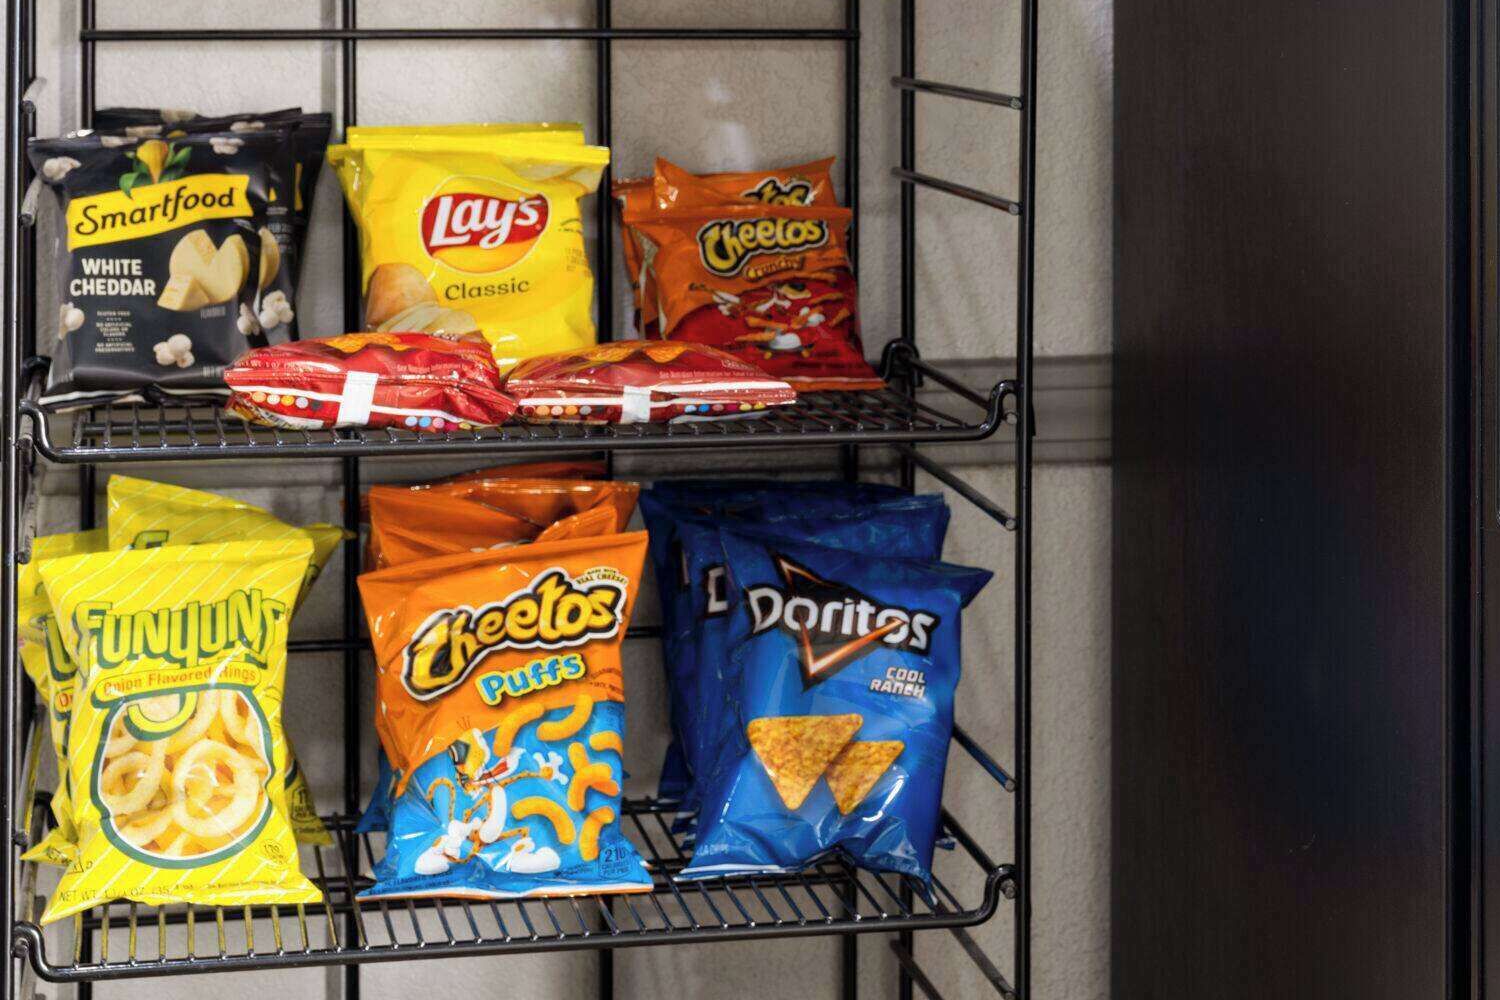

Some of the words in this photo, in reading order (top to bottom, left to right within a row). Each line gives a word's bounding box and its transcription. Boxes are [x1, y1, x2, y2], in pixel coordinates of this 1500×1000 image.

[75, 186, 235, 236] Smartfood
[430, 195, 543, 249] Lay's
[81, 257, 143, 276] WHITE
[702, 218, 824, 271] Cheetos
[69, 279, 156, 296] CHEDDAR
[445, 278, 531, 301] Classic
[73, 589, 287, 674] FUNYUNS
[410, 570, 623, 691] Cheetos
[748, 586, 938, 651] Doritos
[148, 667, 212, 687] Flavored
[482, 655, 584, 705] Puffs
[869, 679, 926, 700] RANCH
[886, 666, 926, 684] COOL
